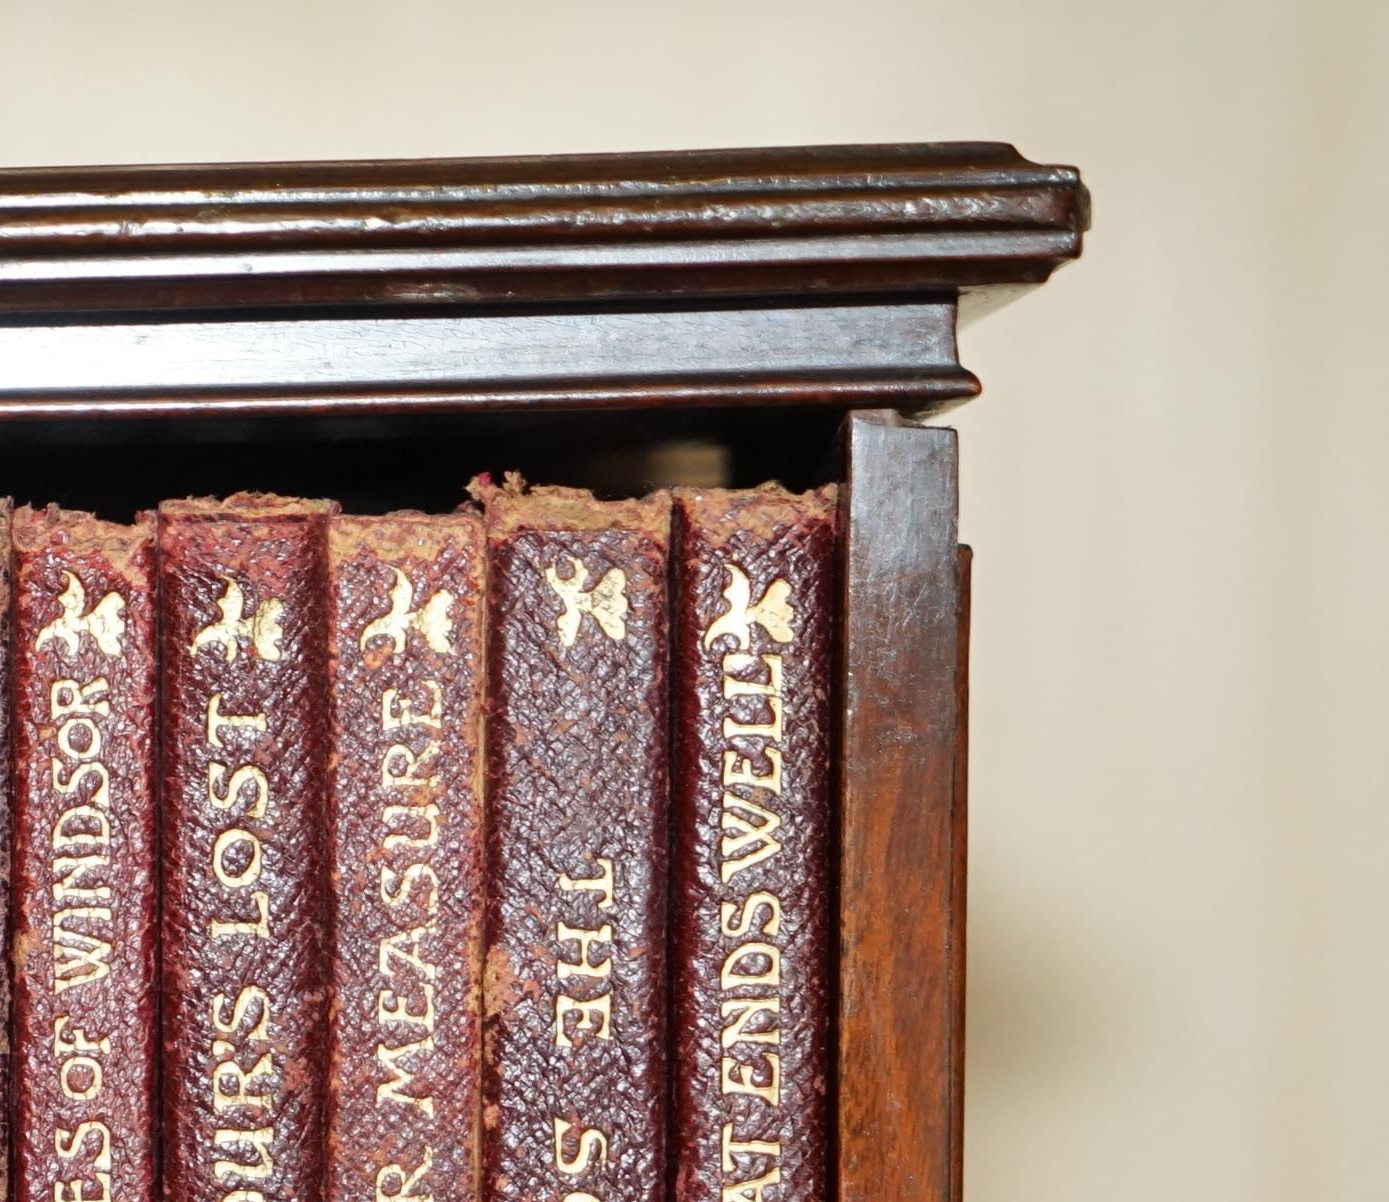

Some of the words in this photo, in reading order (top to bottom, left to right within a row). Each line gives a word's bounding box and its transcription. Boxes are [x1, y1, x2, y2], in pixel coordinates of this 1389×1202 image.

[50, 676, 110, 996] WINDSOR
[208, 687, 268, 939] LOST
[721, 654, 783, 883] WELL
[375, 677, 441, 1113] MEASURE
[556, 854, 613, 1045] THE
[722, 892, 782, 1105] ENDS
[55, 1012, 112, 1100] OF
